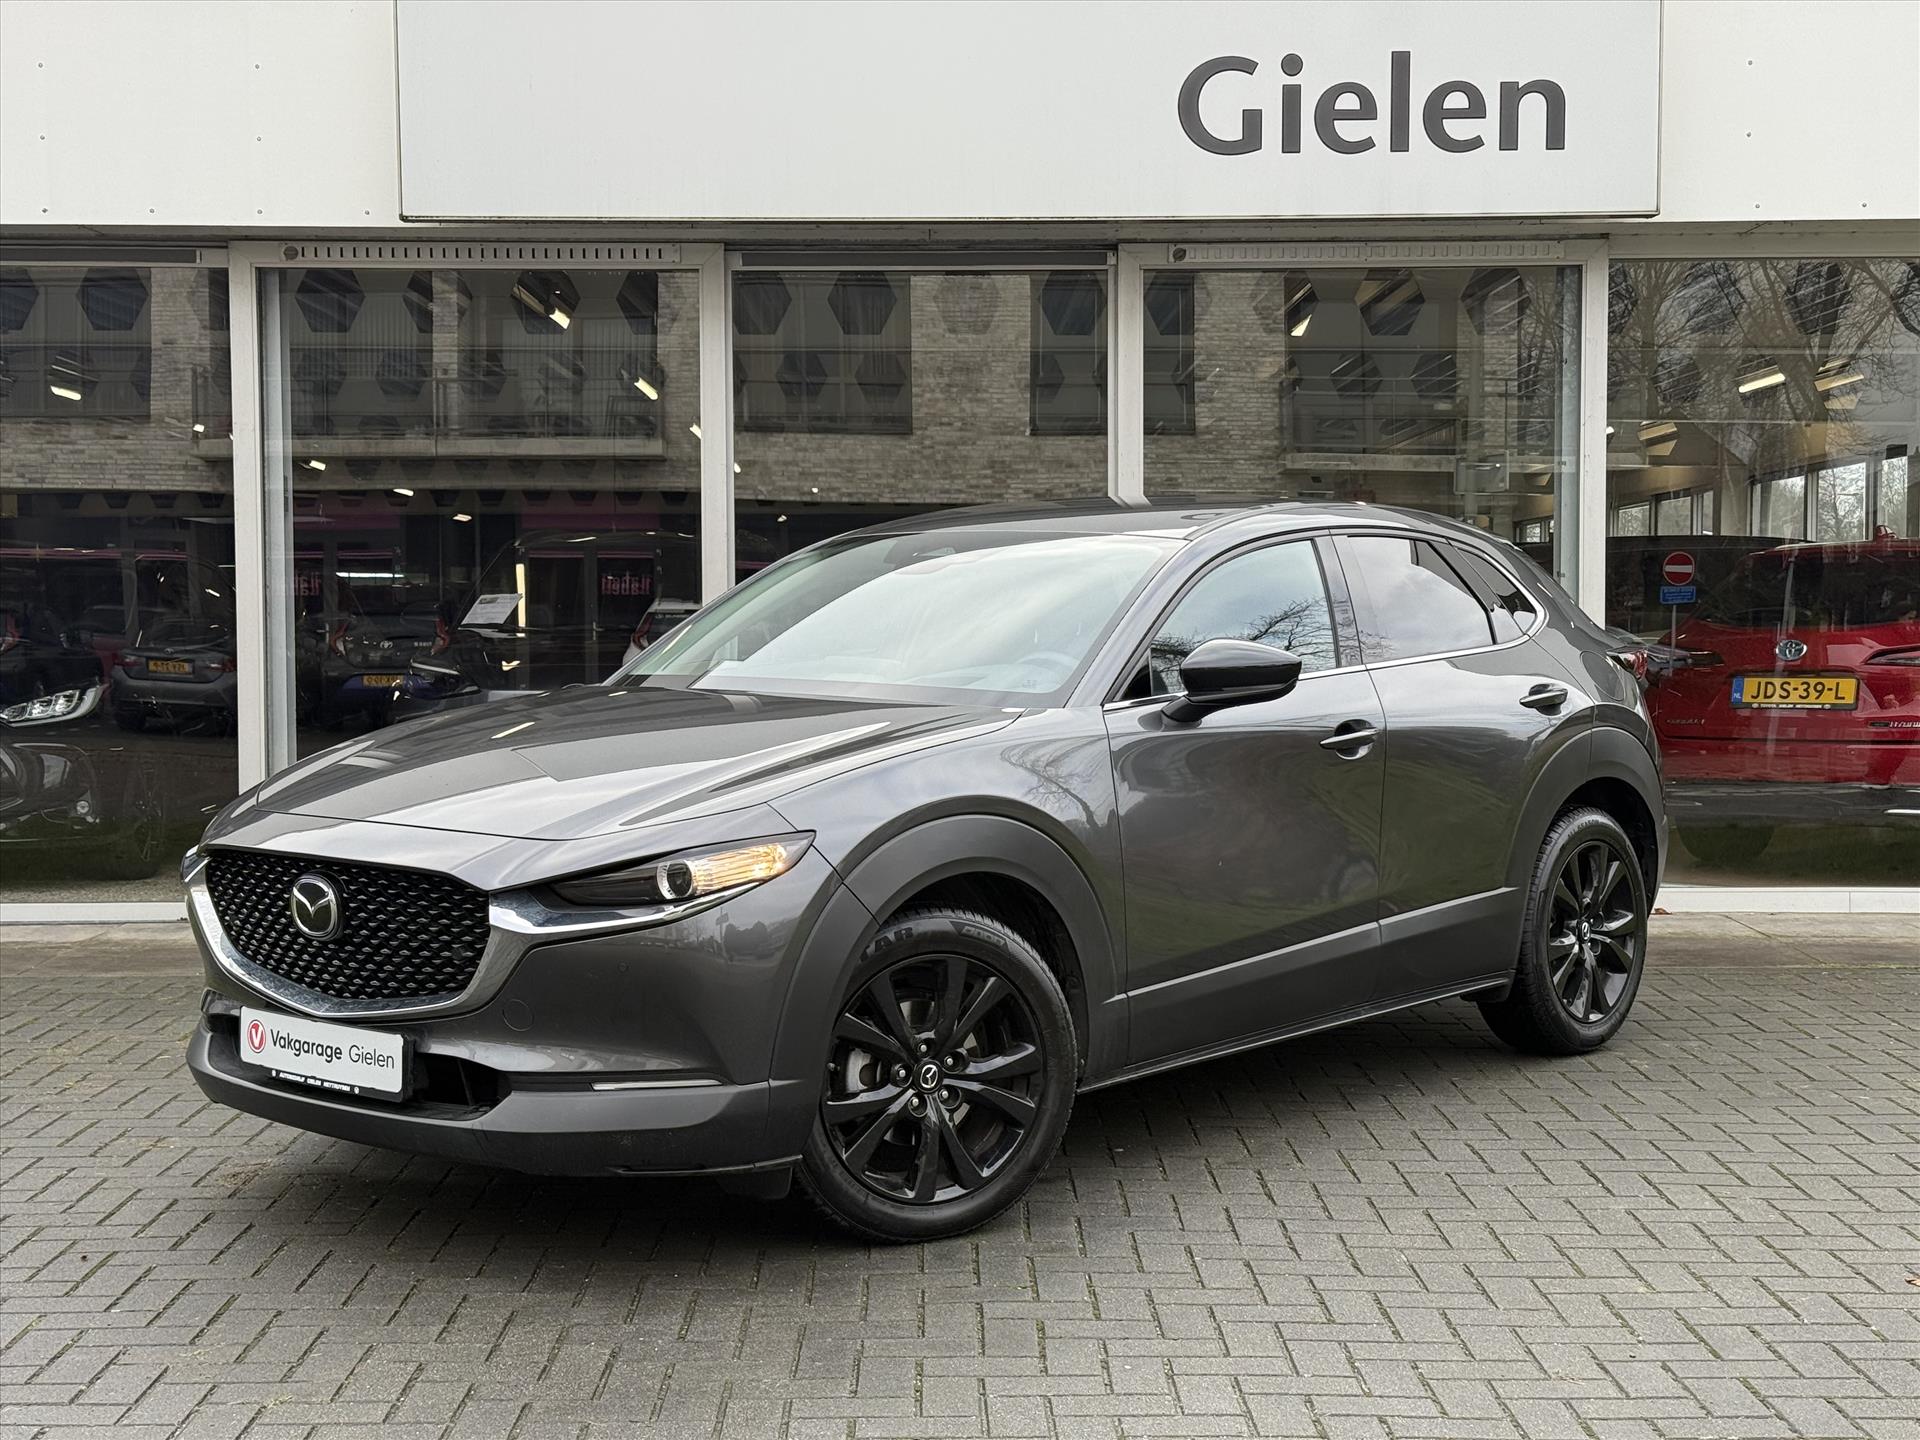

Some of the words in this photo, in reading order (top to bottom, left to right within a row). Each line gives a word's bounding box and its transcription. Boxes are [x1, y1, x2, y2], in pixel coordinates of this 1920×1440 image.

[1177, 51, 1566, 156] Gielen
[1751, 681, 1845, 700] JDS-39-L
[270, 1029, 342, 1063] Vakgarage
[349, 1044, 394, 1069] Gielen
